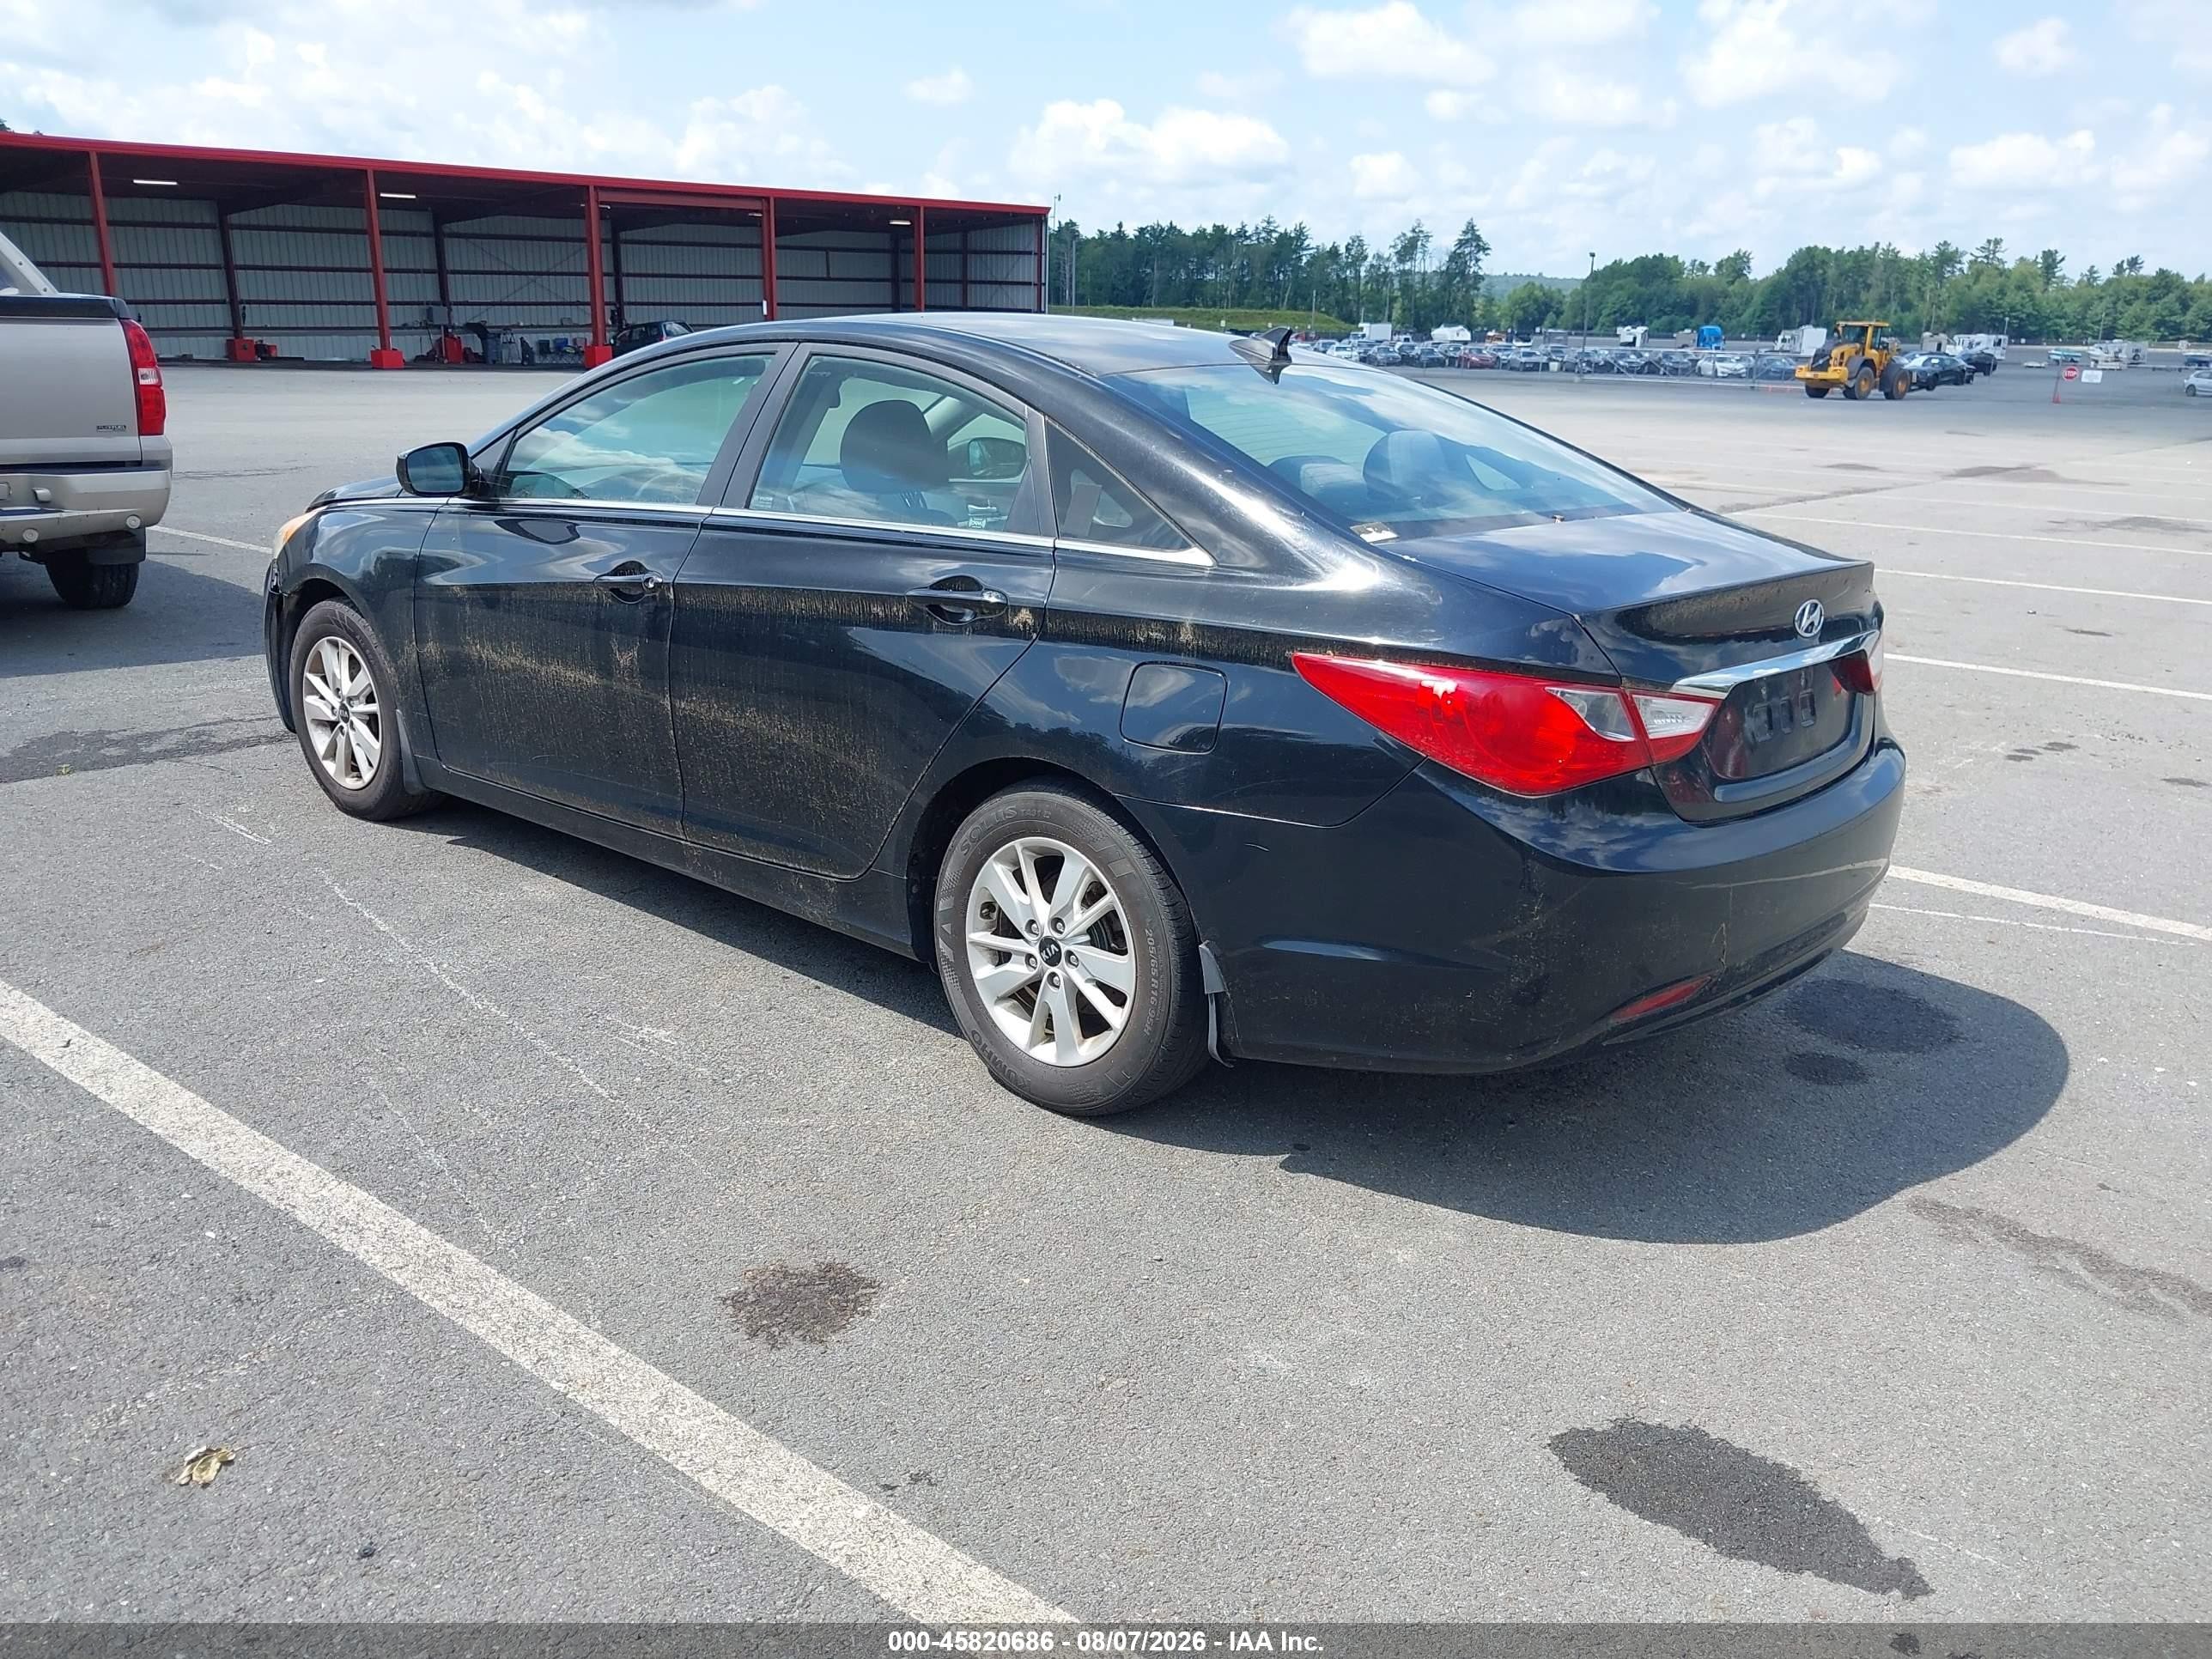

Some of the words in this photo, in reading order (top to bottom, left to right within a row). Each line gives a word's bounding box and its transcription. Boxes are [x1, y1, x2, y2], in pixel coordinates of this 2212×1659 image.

[961, 805, 1018, 856] SOLUS
[1041, 944, 1060, 962] KIA
[1145, 927, 1159, 977] 205/65
[1150, 977, 1159, 1006] R16
[971, 1030, 1030, 1089] KUMHO
